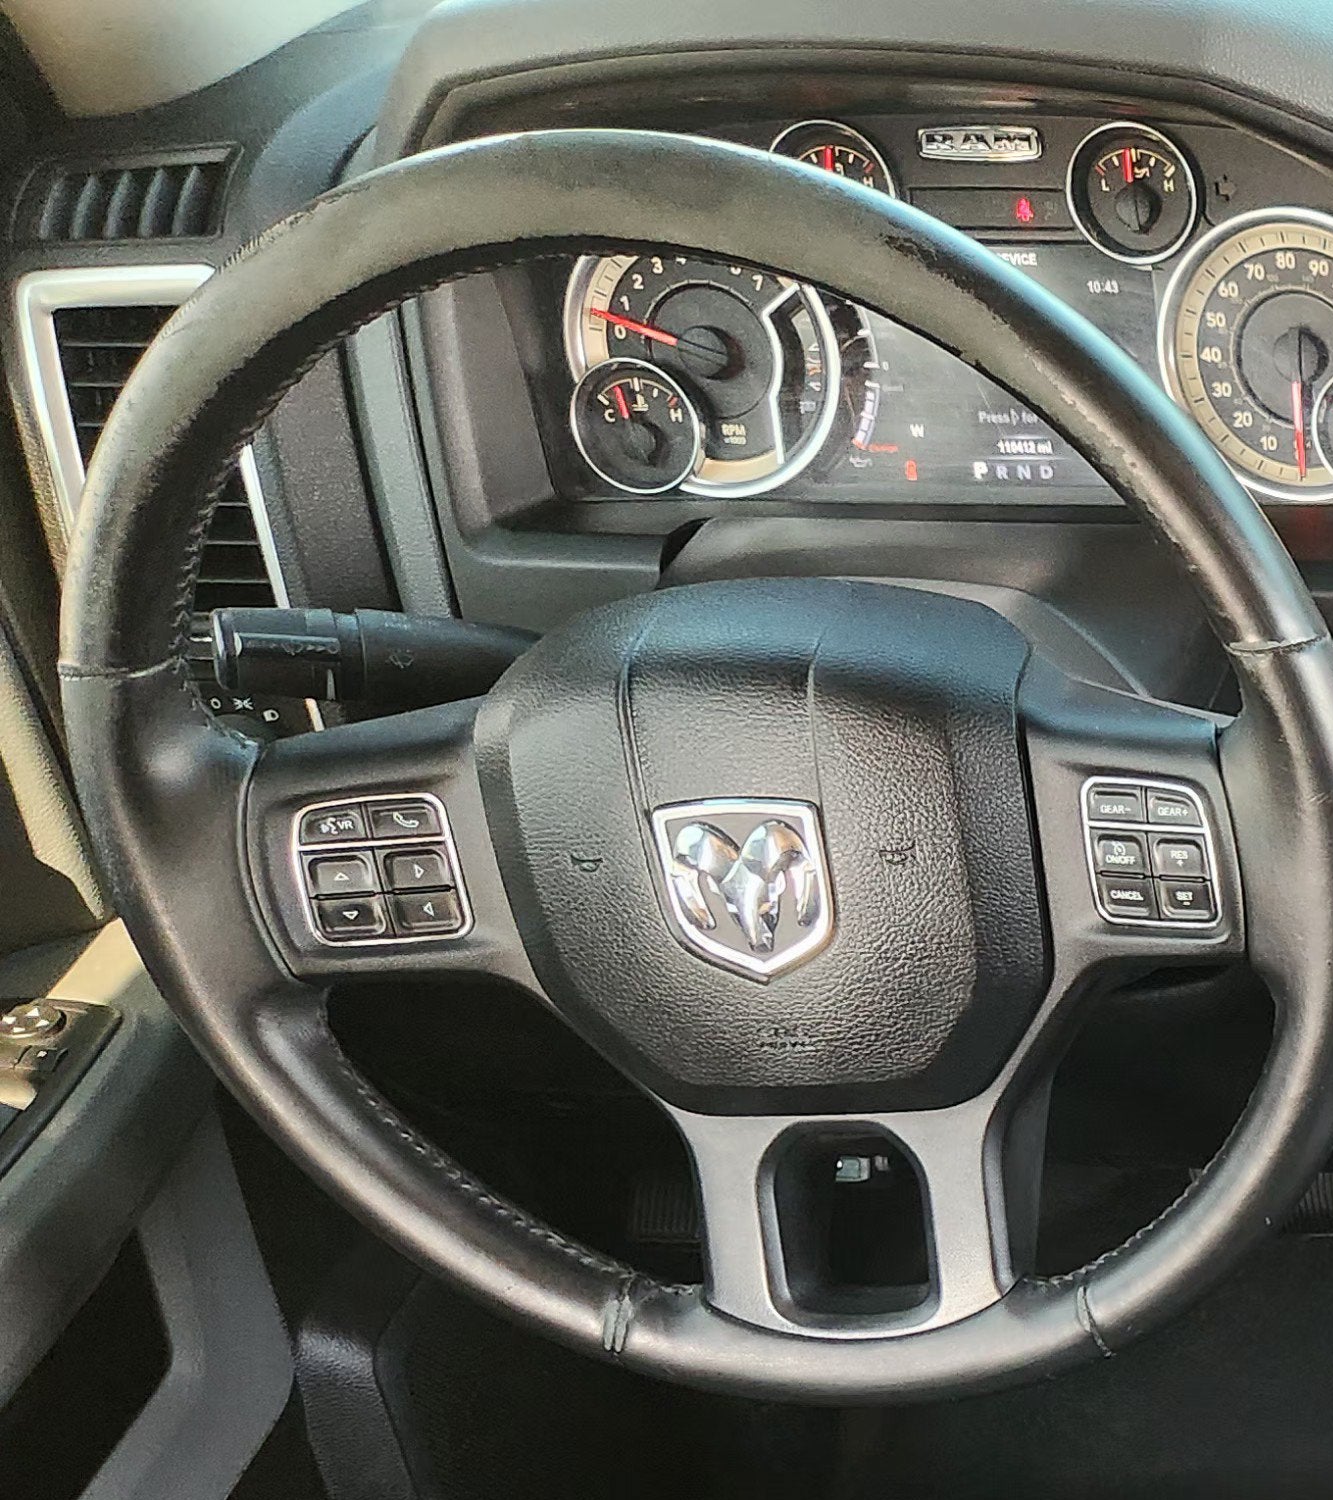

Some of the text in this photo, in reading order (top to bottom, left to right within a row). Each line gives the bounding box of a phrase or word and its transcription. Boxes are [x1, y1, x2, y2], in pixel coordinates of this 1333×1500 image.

[926, 134, 1030, 151] RAM
[1101, 179, 1110, 191] L
[1163, 179, 1174, 191] H
[1275, 252, 1296, 269] 80
[1308, 260, 1329, 276] 90
[1243, 263, 1265, 280] 70
[632, 274, 644, 290] 2
[1218, 281, 1239, 298] 60
[620, 296, 630, 311] 1
[1206, 312, 1227, 328] 50
[614, 325, 627, 339] 0
[1200, 346, 1222, 364] 40
[1212, 382, 1232, 398] 30
[604, 408, 616, 423] C
[669, 408, 683, 423] H
[1233, 411, 1253, 428] 20
[909, 423, 925, 438] W
[1260, 436, 1277, 451] 10
[973, 461, 1054, 480] P R N D
[339, 820, 354, 830] VR
